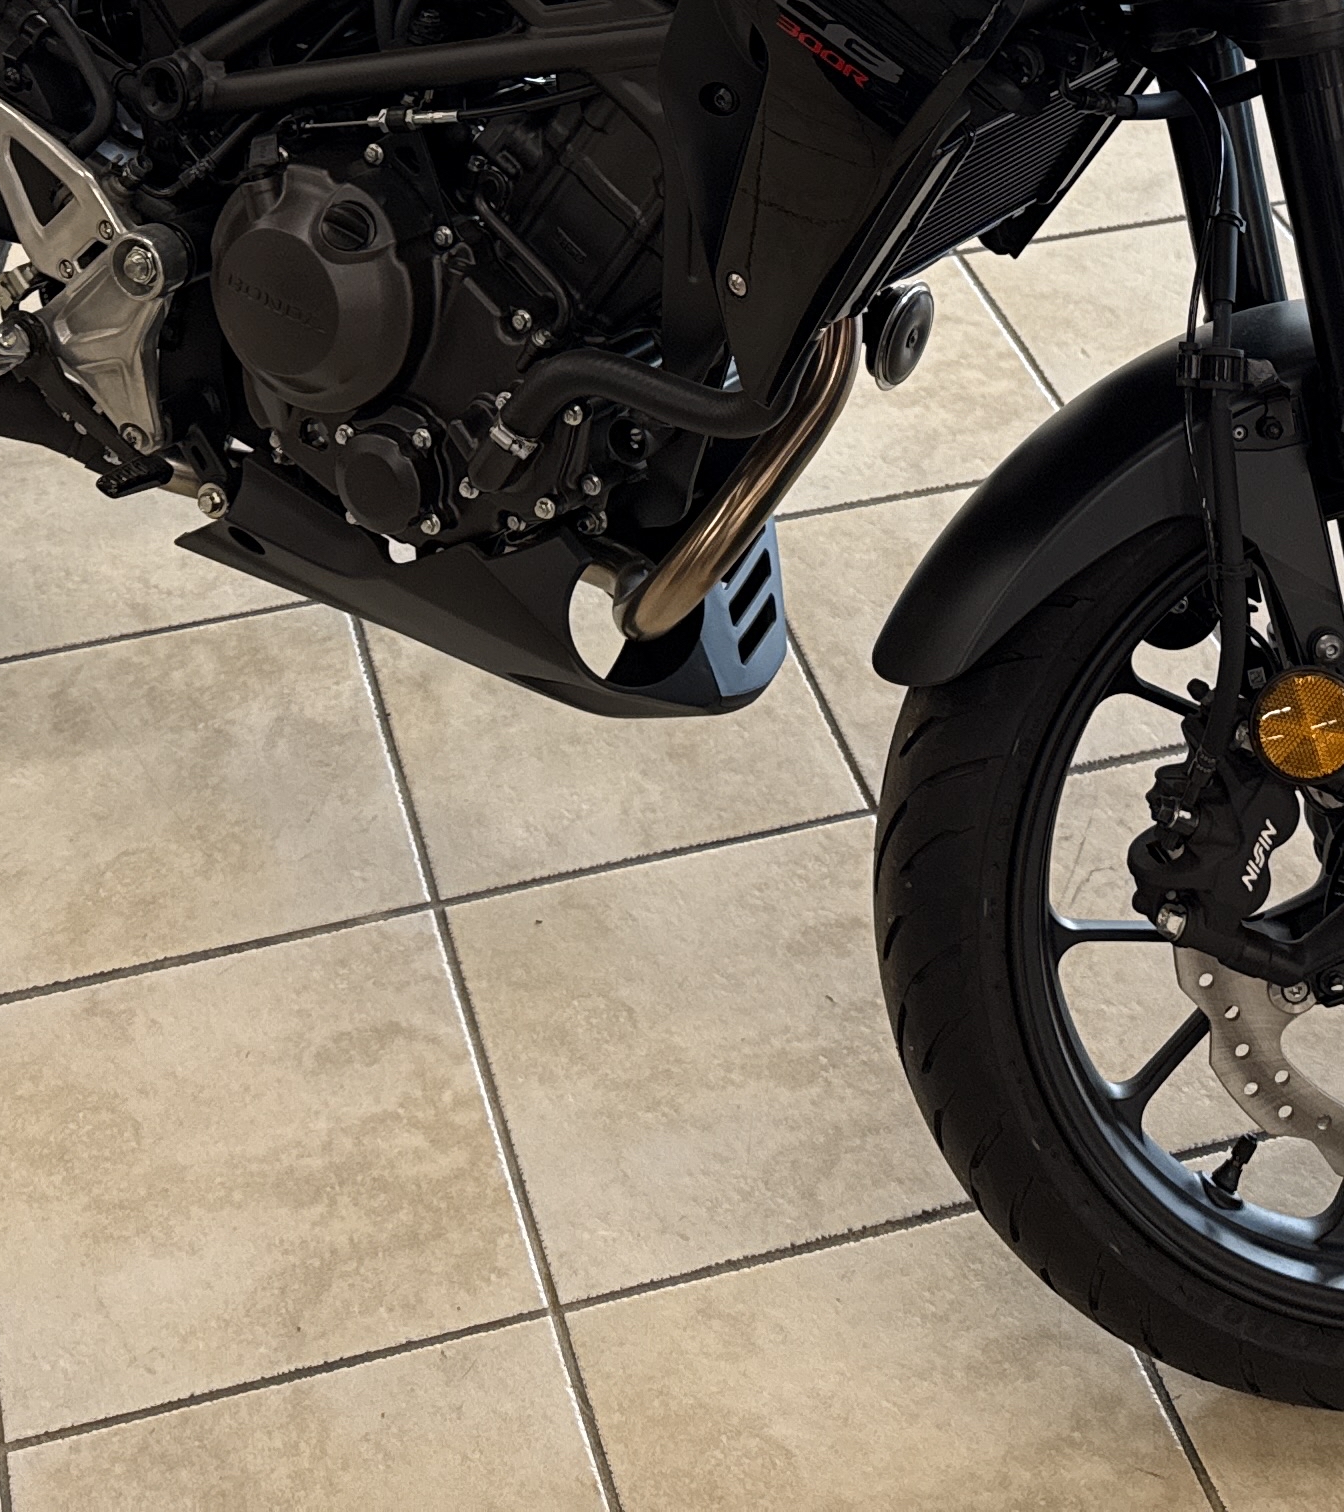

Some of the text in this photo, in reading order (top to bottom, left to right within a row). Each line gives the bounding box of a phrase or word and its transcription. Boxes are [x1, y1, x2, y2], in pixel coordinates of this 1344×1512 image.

[776, 14, 869, 88] 300R
[228, 273, 327, 334] HONDA
[1241, 818, 1277, 892] NISSIN
